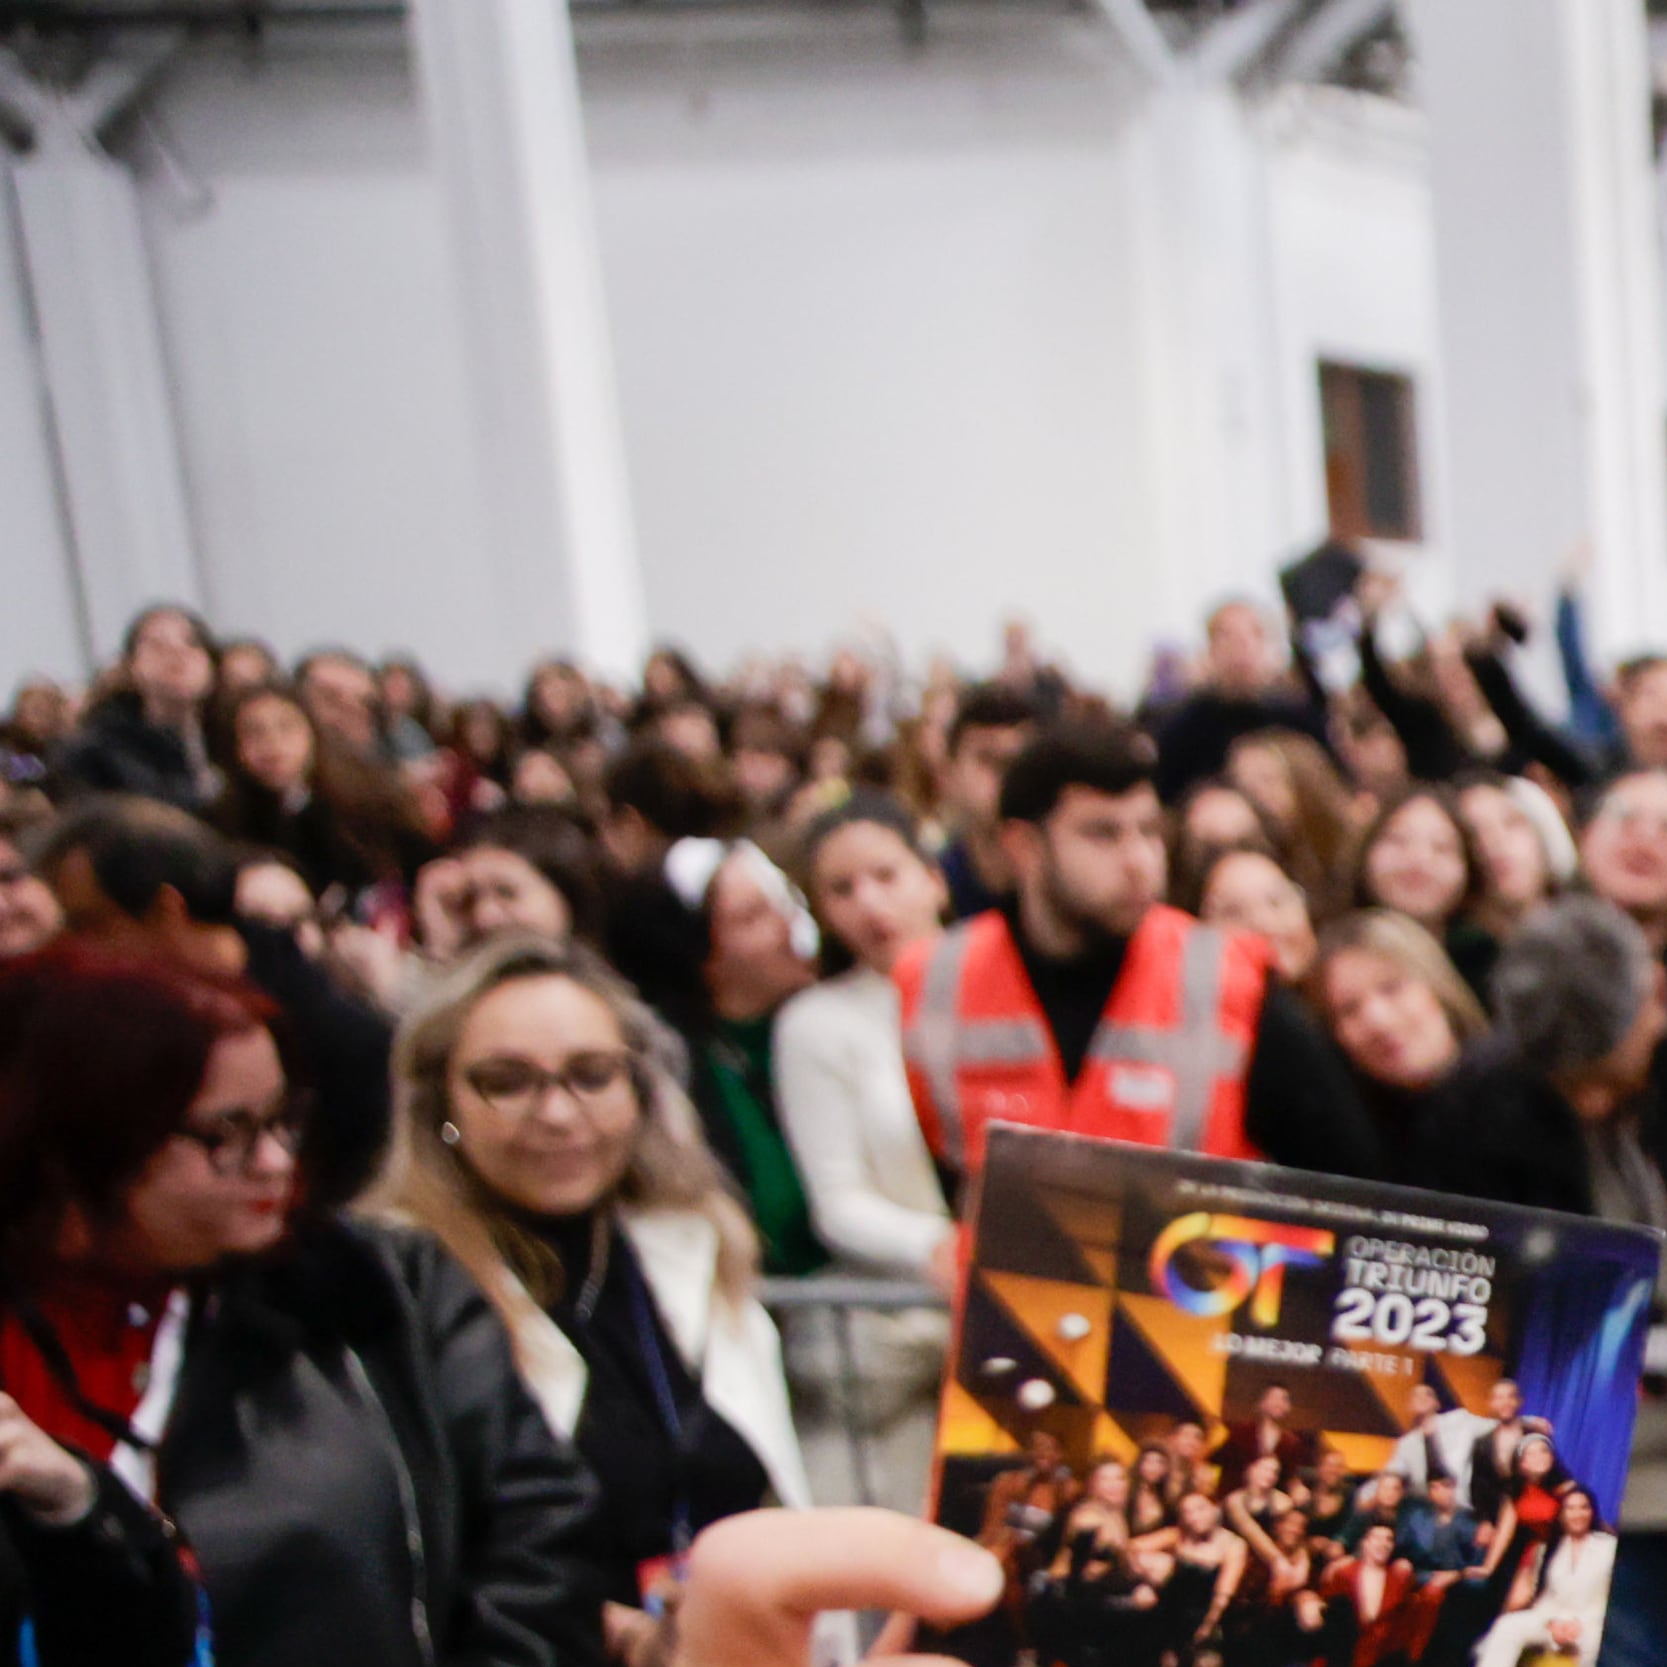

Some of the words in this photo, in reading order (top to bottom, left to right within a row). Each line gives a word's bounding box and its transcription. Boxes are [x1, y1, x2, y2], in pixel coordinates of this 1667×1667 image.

[1149, 1211, 1336, 1328] OT
[1346, 1236, 1495, 1279] OPERACIÓN
[1346, 1259, 1492, 1304] TRIUNFO
[1333, 1287, 1488, 1355] 2023
[1244, 1335, 1323, 1364] MEJOR
[1326, 1347, 1398, 1375] PARTE
